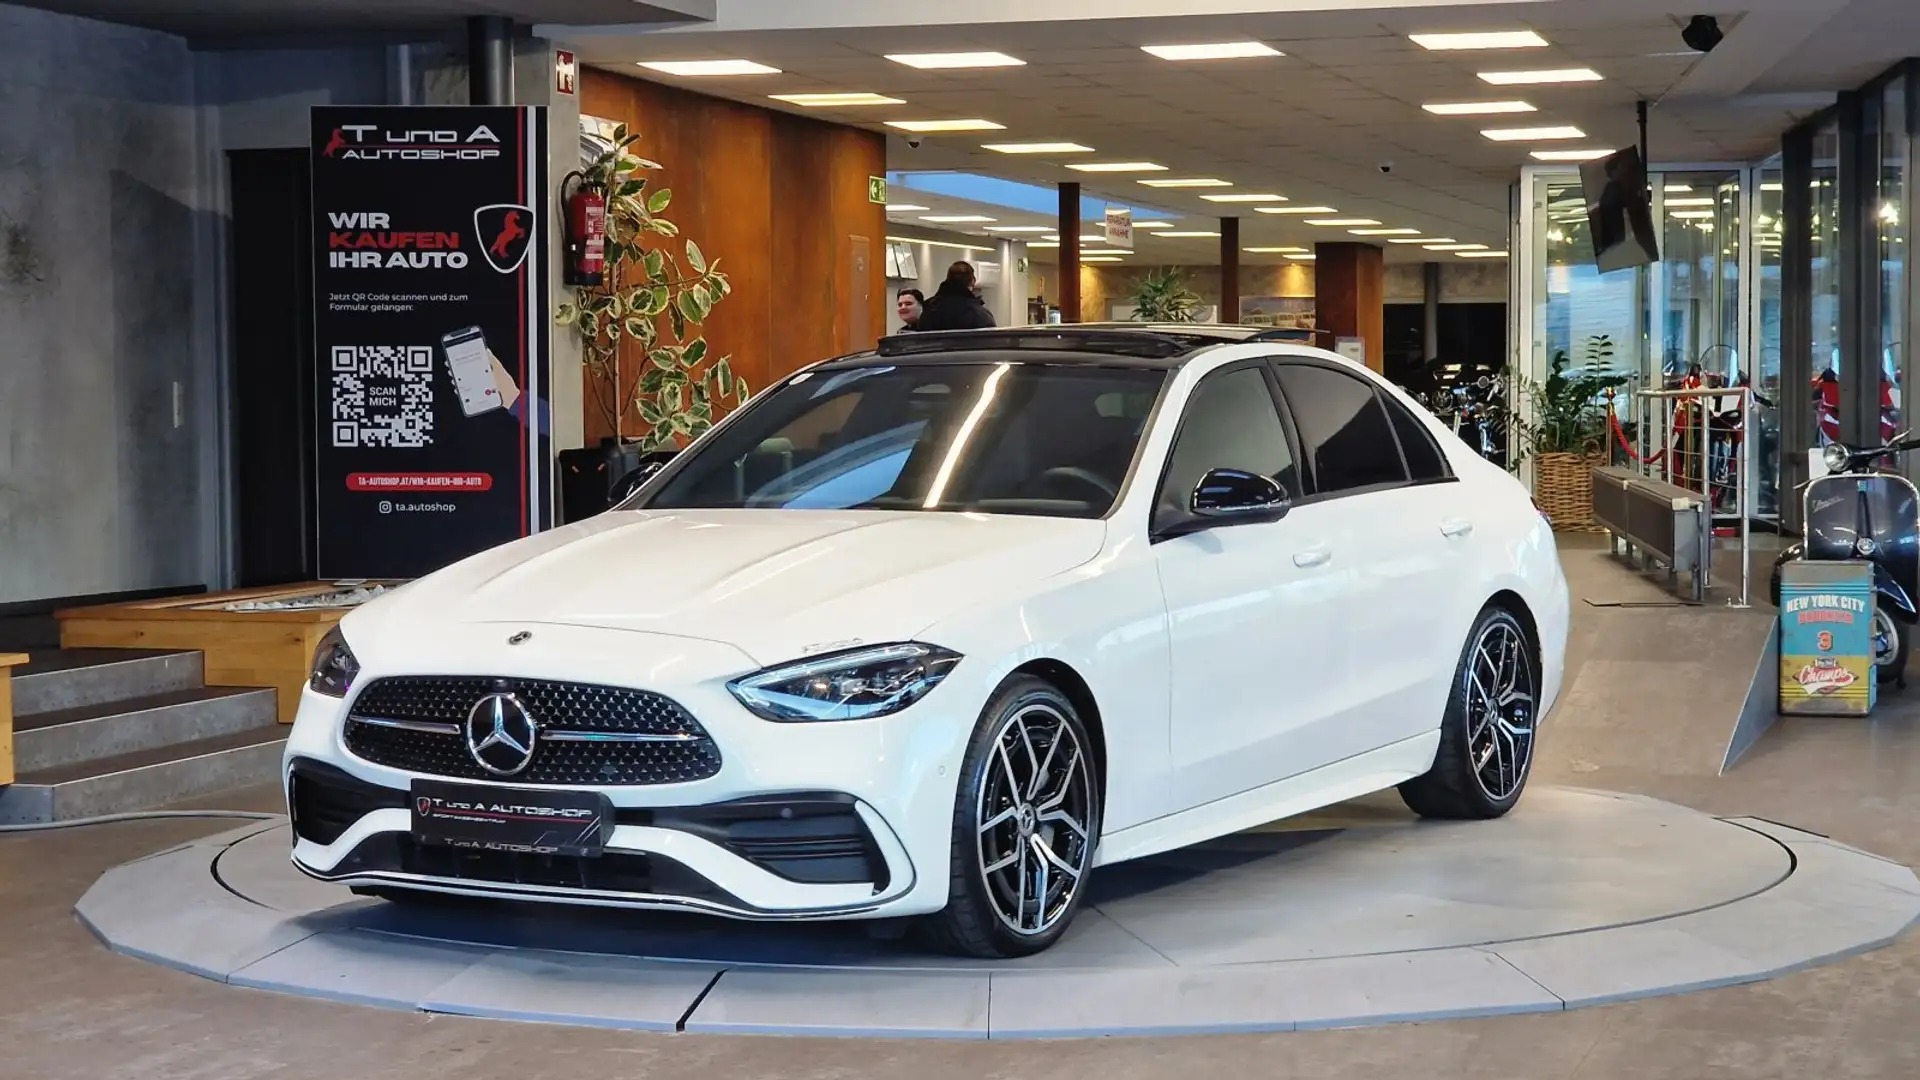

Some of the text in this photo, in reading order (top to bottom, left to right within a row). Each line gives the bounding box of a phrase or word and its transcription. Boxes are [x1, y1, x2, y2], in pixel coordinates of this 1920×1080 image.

[342, 125, 377, 142] T
[465, 125, 501, 142] A
[342, 149, 500, 159] AUTOSHOP
[328, 212, 390, 229] WIR
[329, 232, 459, 249] KAUFEN
[329, 252, 468, 269] IHR AUTO
[329, 293, 350, 301] Jetzt
[352, 293, 366, 302] QR
[368, 293, 389, 301] Code
[430, 293, 447, 301] und
[329, 303, 414, 313] Formular gelangen:
[369, 386, 396, 396] SCAN
[369, 397, 396, 407] MICH
[395, 502, 456, 513] ta.autoshop
[1786, 595, 1865, 613] NEW YORK CITY
[1817, 631, 1833, 653] 3
[1799, 665, 1851, 685] Champs
[432, 798, 443, 806] T
[490, 804, 592, 817] AUTOSHOP
[485, 841, 558, 853] AUTOSHOP
